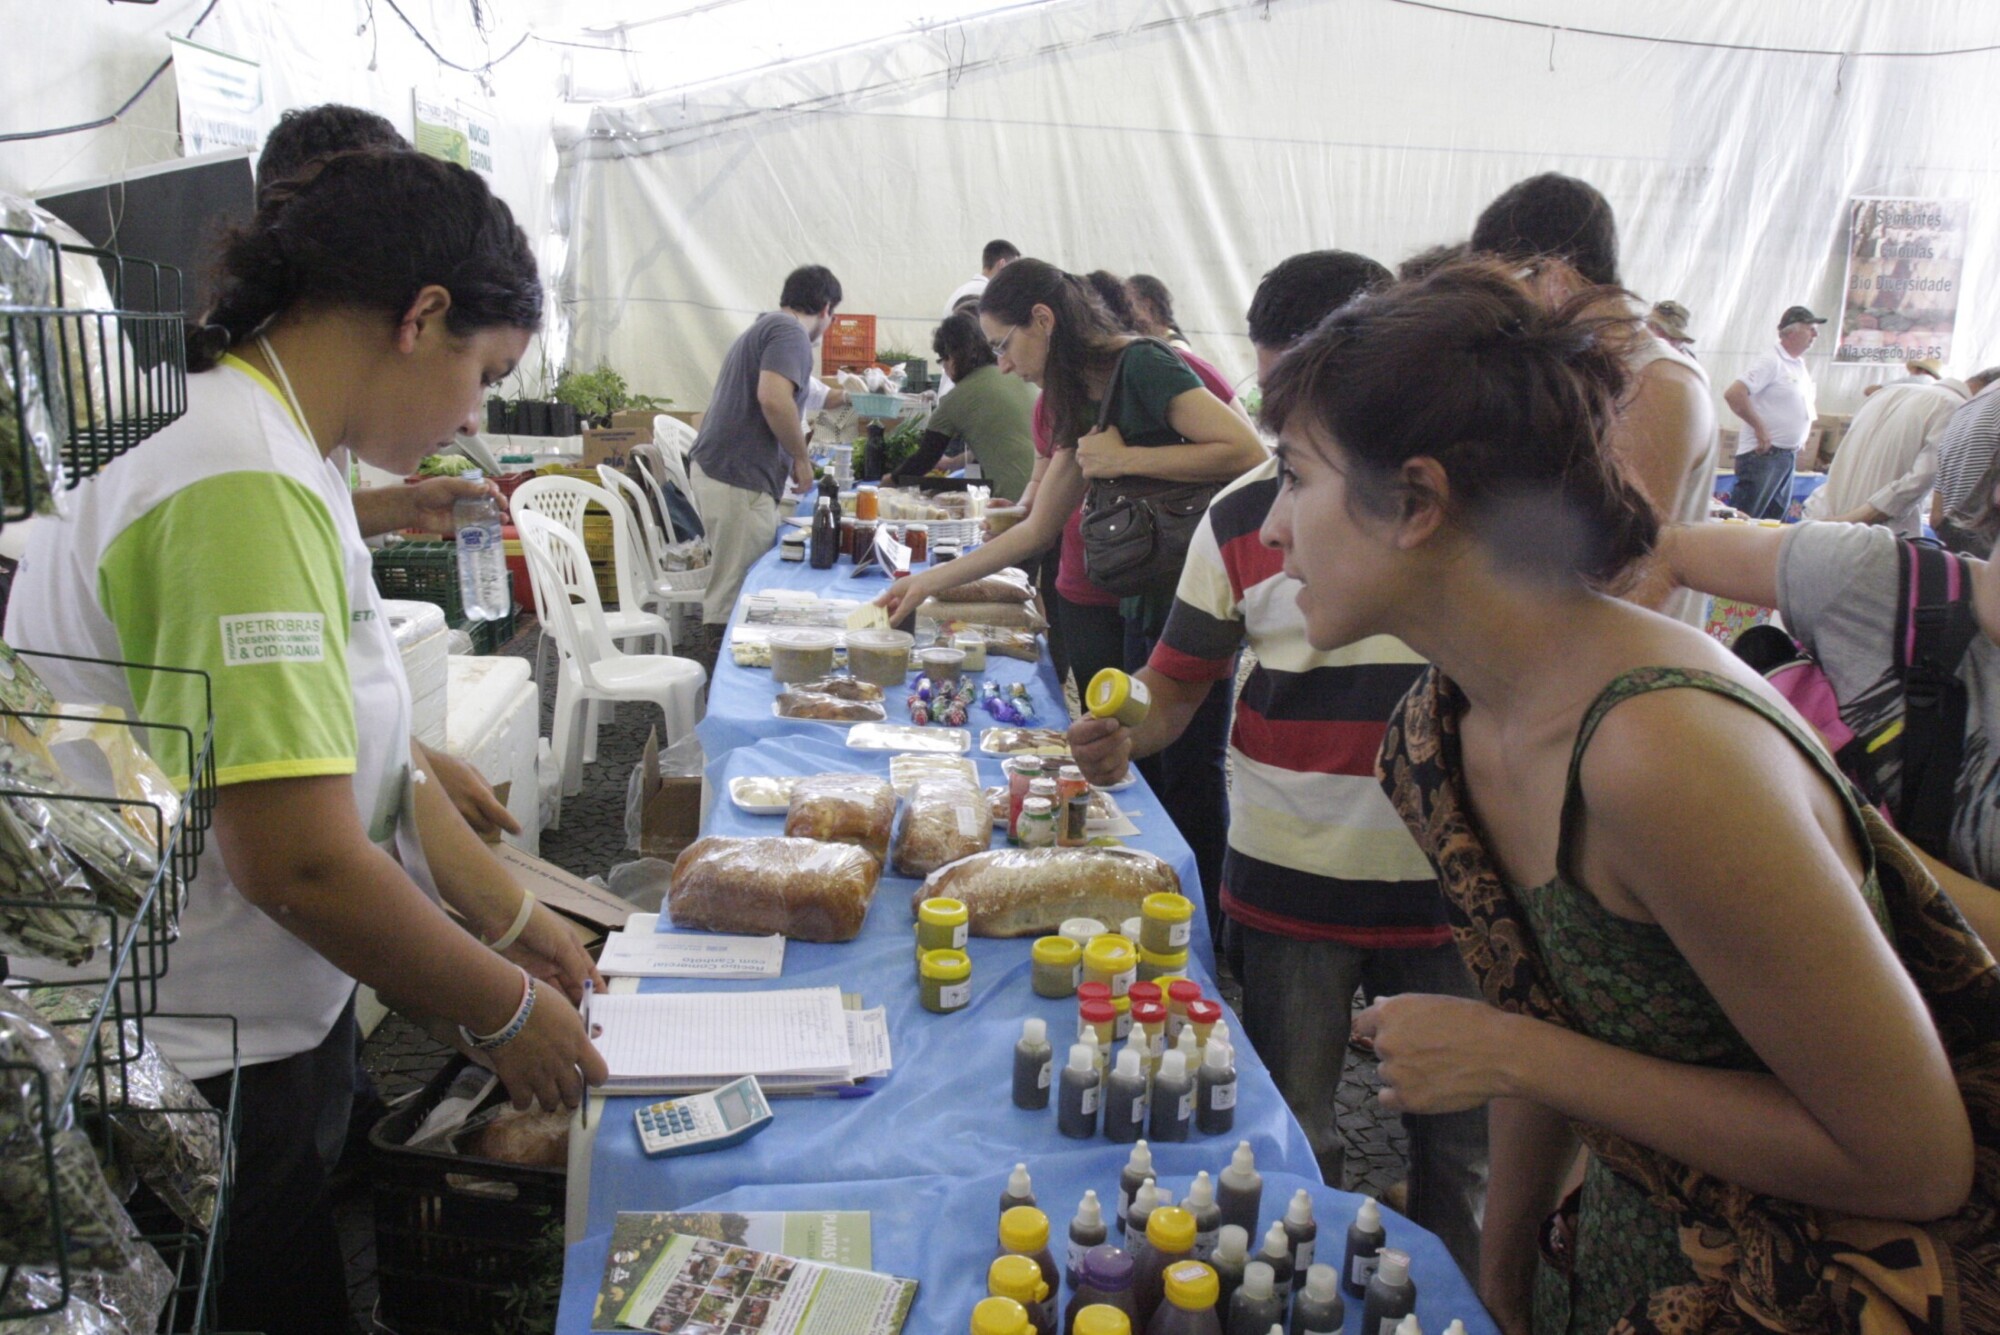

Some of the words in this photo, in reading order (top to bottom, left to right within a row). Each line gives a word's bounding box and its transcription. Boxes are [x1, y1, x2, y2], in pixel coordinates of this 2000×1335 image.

[1876, 209, 1942, 227] Sementes
[1850, 276, 1871, 290] Bio
[1876, 275, 1952, 292] Diversidade
[234, 619, 321, 634] PETROBRAS
[236, 634, 320, 645] DESENVOLVIMENTO
[240, 647, 250, 660] &
[253, 645, 321, 658] CIDADANIA
[821, 1213, 838, 1259] PLANTAS
